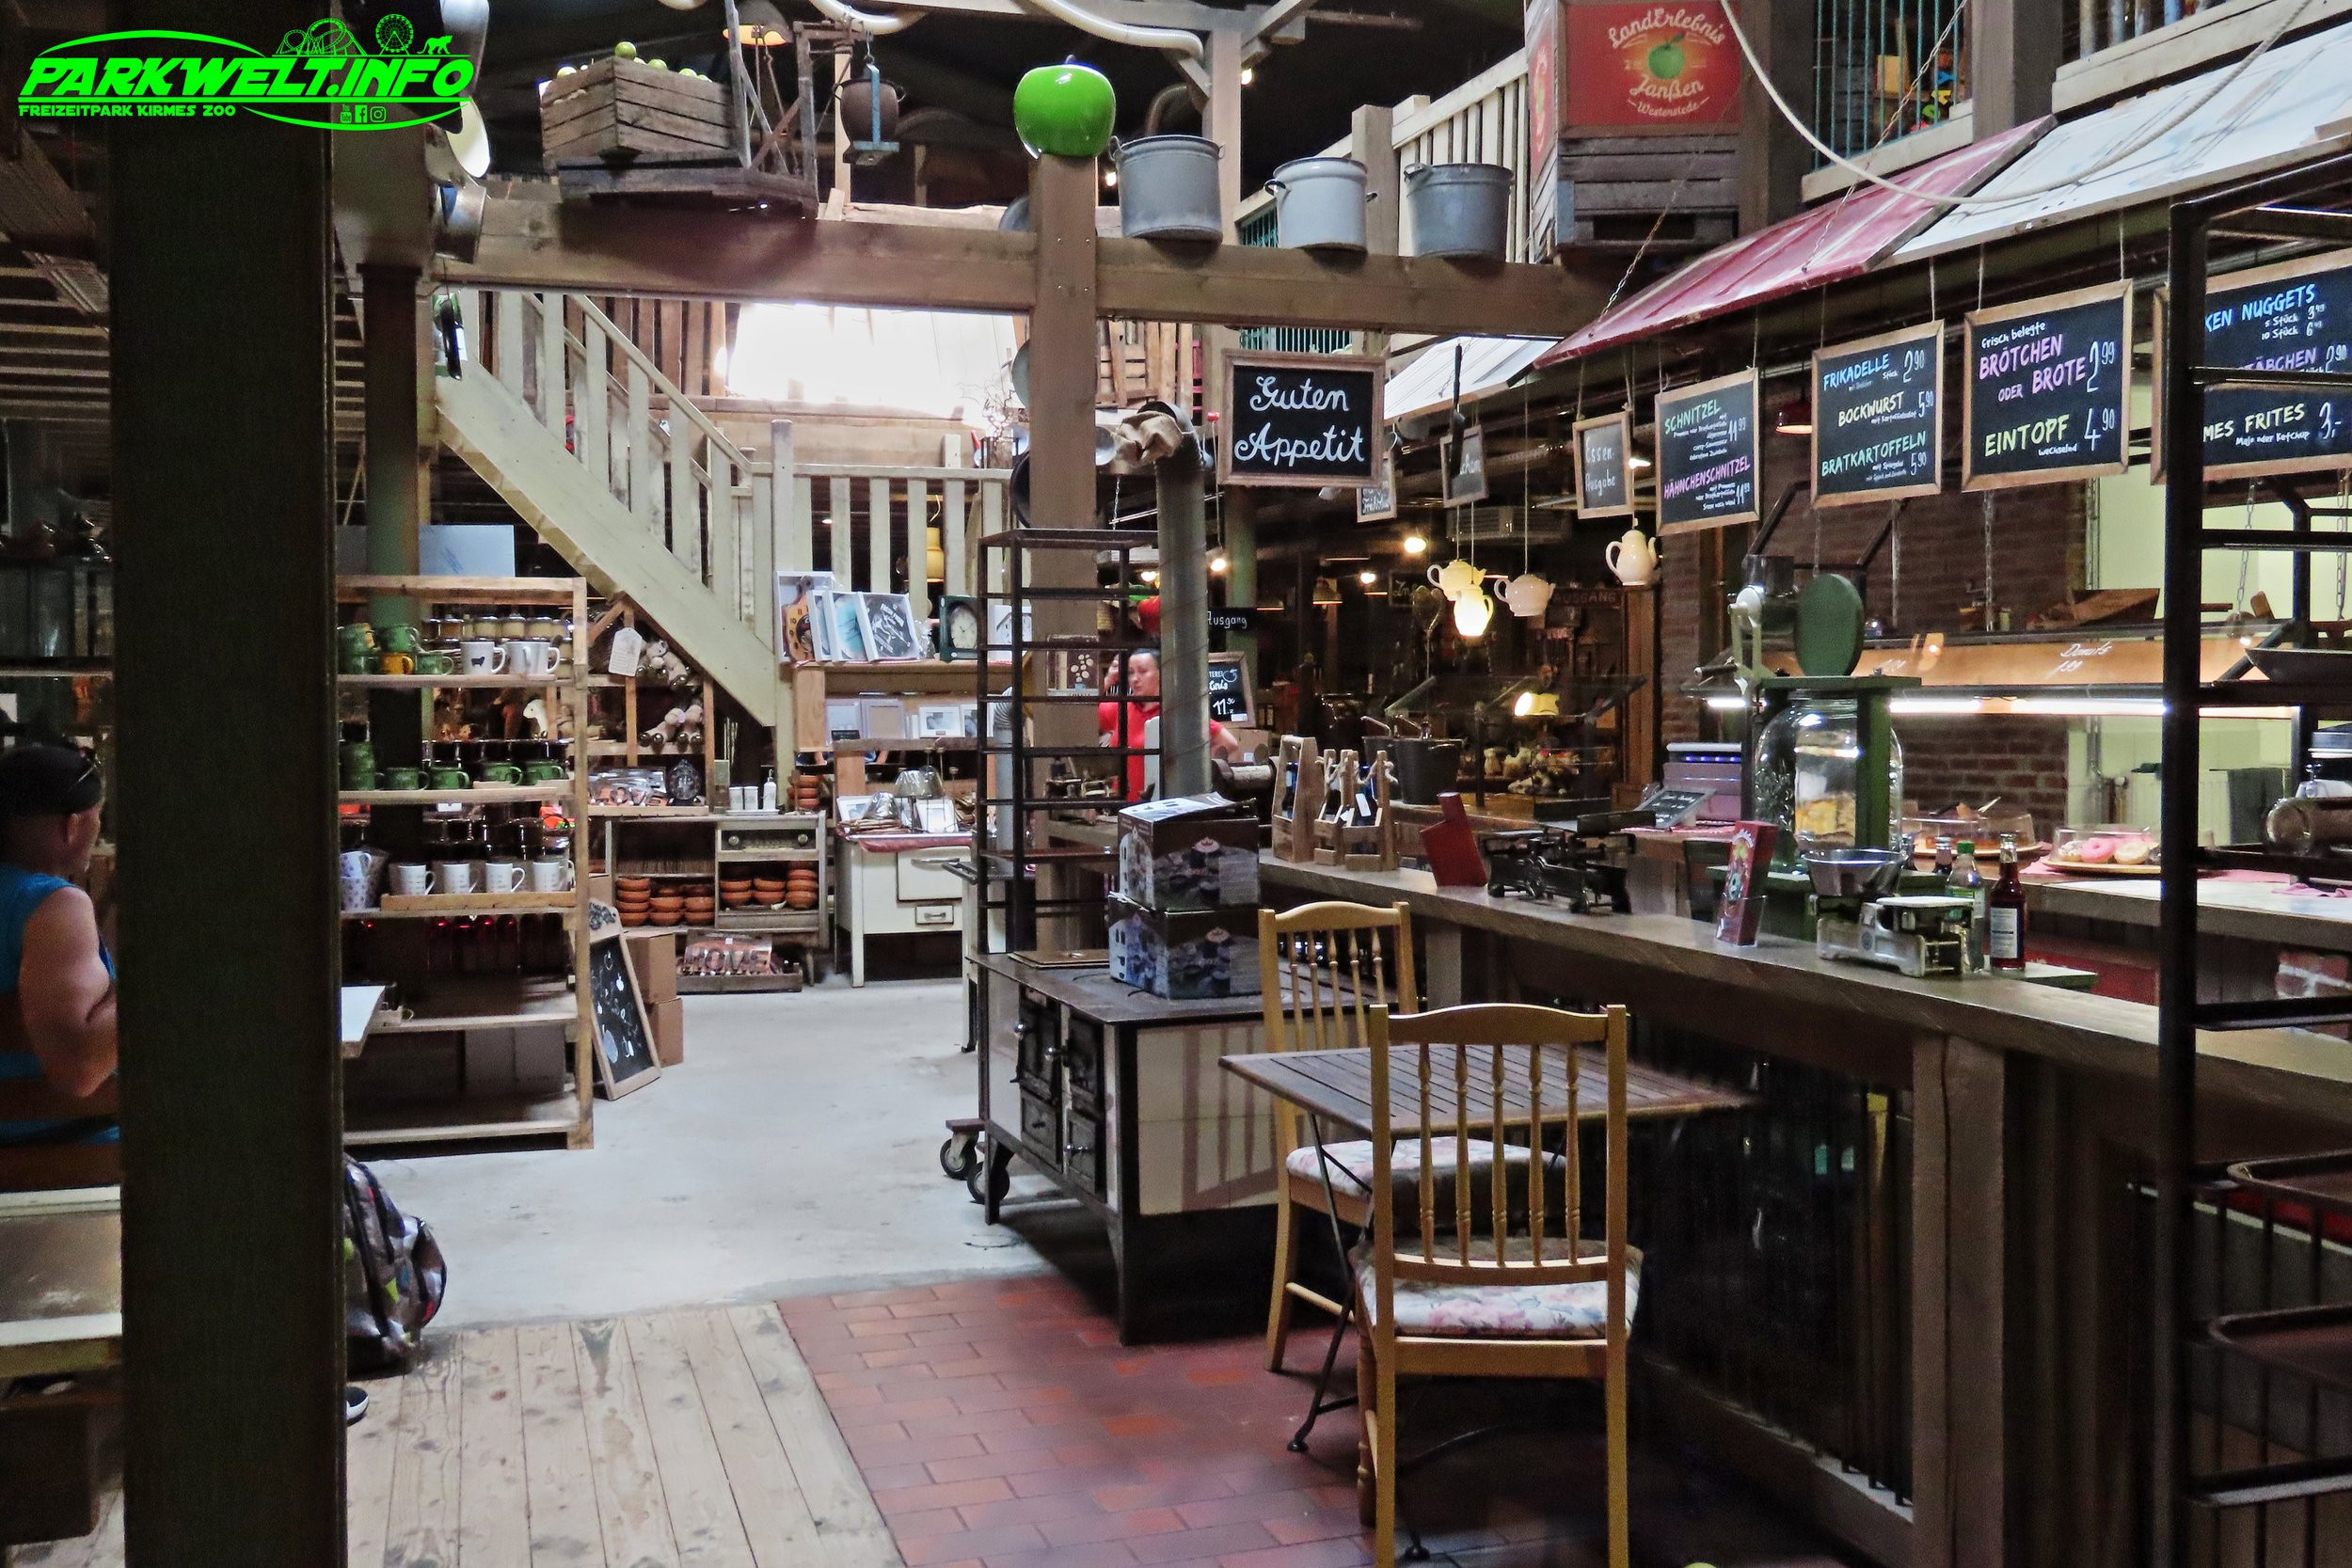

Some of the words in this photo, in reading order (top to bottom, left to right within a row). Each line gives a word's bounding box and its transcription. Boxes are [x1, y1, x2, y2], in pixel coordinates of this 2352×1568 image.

[2242, 283, 2316, 322] NUGGETS
[2011, 321, 2046, 340] belegte
[1823, 353, 1890, 391] FRIKADELLE
[1979, 333, 2063, 380] BRÖTCHEN
[1249, 376, 1349, 411] Guten
[1998, 384, 2023, 403] ODER
[2032, 356, 2086, 394] BROTE
[1664, 399, 1722, 435] SCHNITZEL
[1837, 391, 1905, 428] BOCKWURST
[2245, 403, 2306, 434] FRITES
[1234, 421, 1365, 467] Appetit
[1821, 431, 1926, 477] BRATKARTOFFELN
[1984, 414, 2070, 457] EINTOPF
[1664, 455, 1751, 499] HÄHNCHENSCHNITZEL
